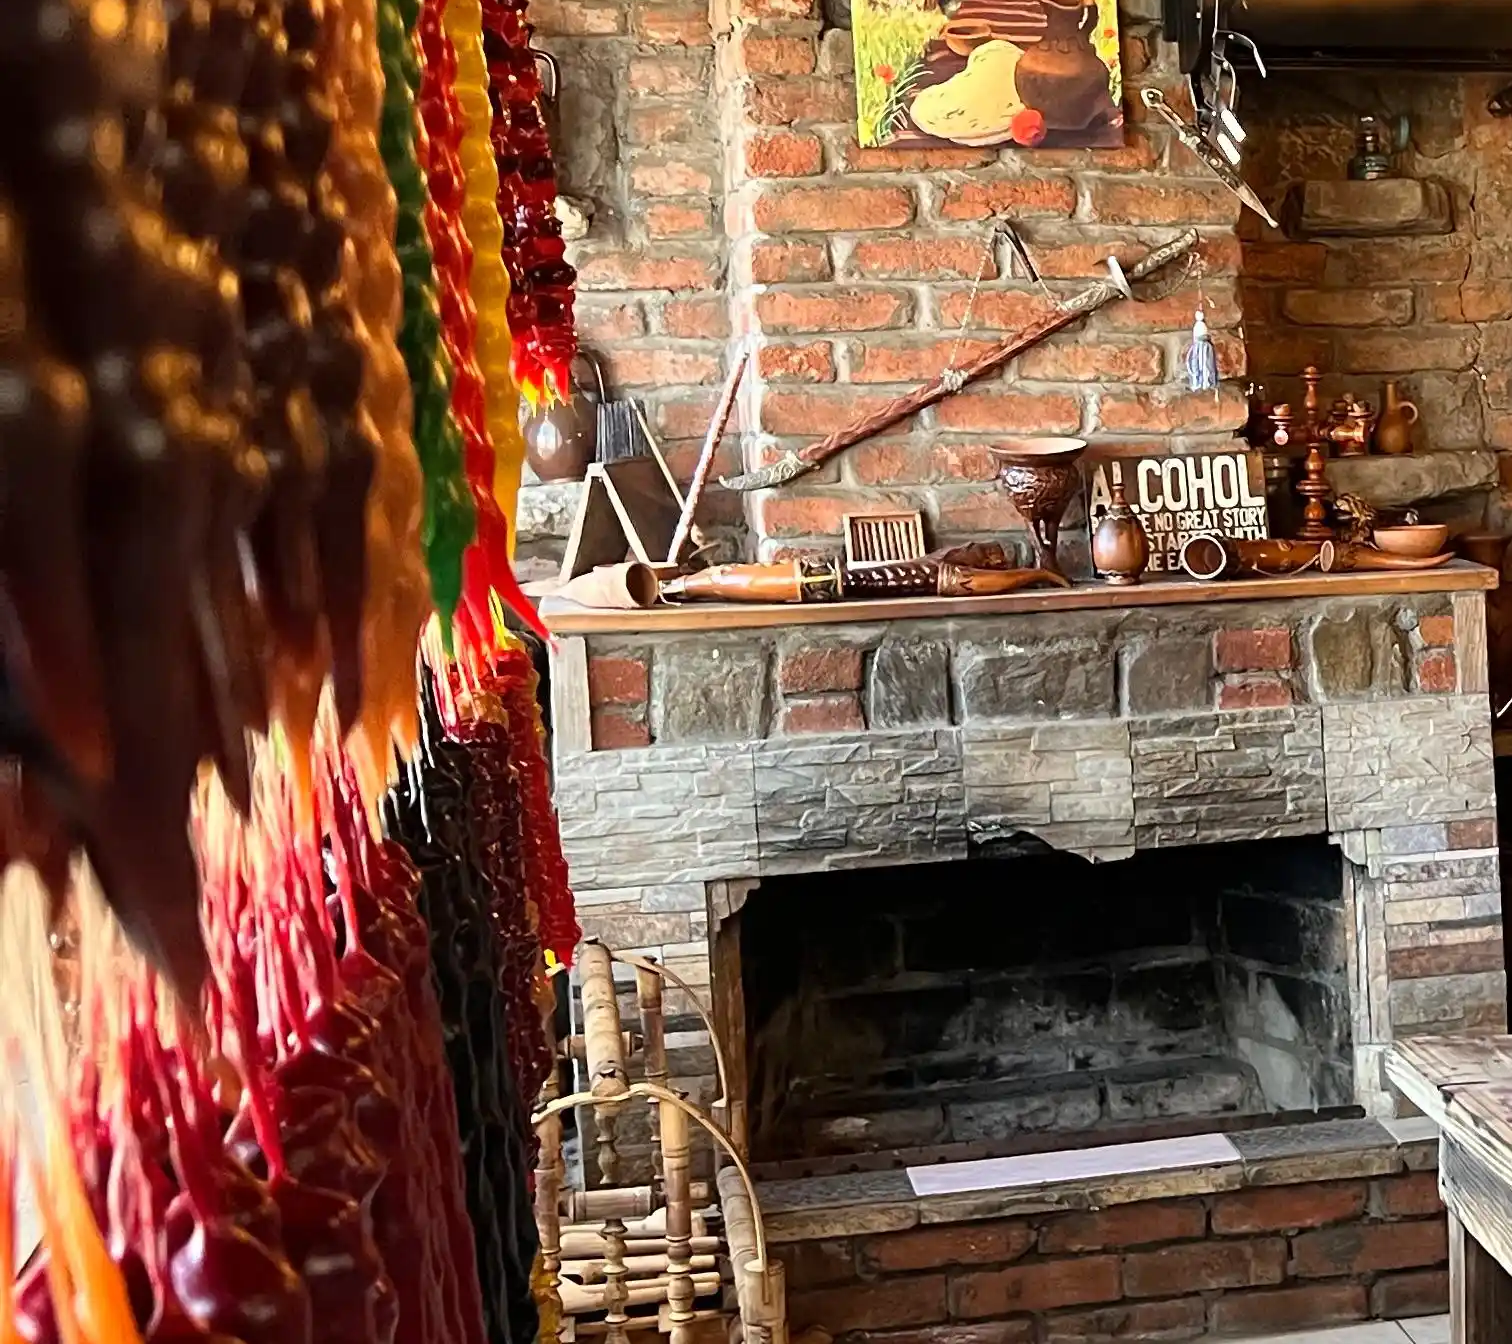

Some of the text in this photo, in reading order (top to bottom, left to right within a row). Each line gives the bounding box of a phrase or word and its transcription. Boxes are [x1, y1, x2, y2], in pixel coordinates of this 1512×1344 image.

[1154, 512, 1173, 533] NO
[1176, 509, 1220, 531] GREAT
[1222, 506, 1266, 528] STORY
[1147, 528, 1224, 552] STAR
